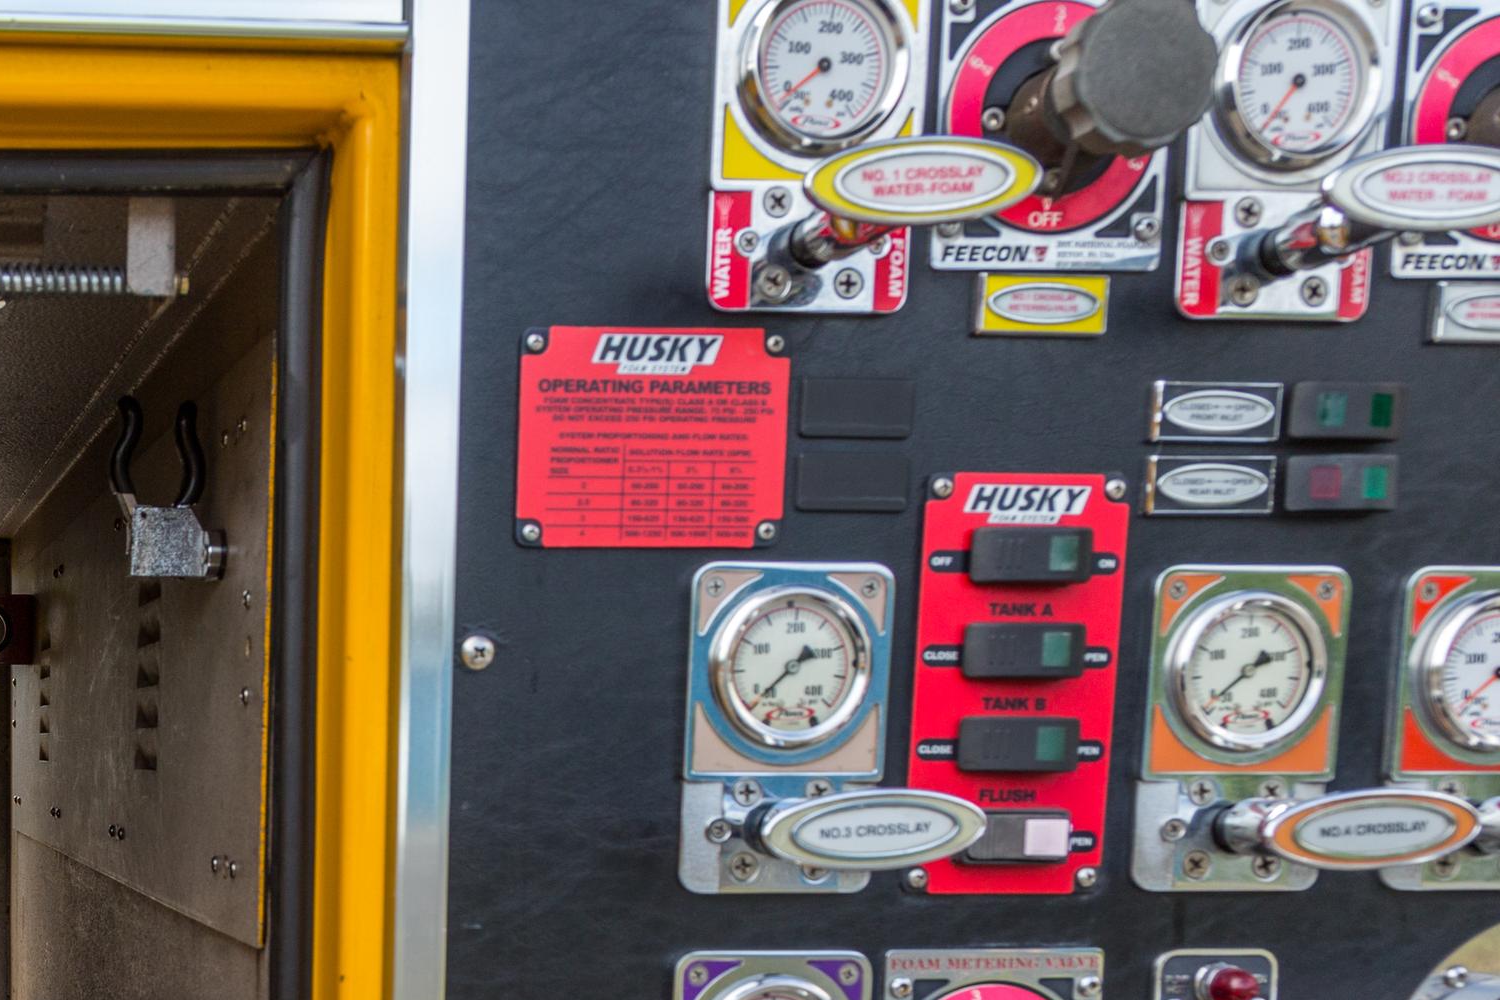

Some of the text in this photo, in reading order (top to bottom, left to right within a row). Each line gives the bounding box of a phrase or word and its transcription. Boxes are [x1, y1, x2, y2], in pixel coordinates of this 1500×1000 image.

[818, 20, 843, 34] 200
[788, 41, 811, 54] 100
[1287, 37, 1312, 51] 200
[840, 51, 864, 65] 300
[783, 80, 792, 92] 0
[830, 89, 854, 102] 400
[905, 165, 985, 181] CROSSLAY
[1419, 171, 1491, 183] CROSSLAY
[872, 182, 974, 196] WATER-FOAM
[1388, 190, 1488, 201] WATER FOAM
[1028, 212, 1064, 226] OFF
[941, 246, 1029, 262] FEECON
[712, 227, 733, 299] WATER
[888, 238, 904, 298] FOAM
[1402, 254, 1486, 270] FEECON
[1183, 237, 1202, 306] WATER
[600, 335, 718, 362] HUSKY
[538, 379, 771, 395] OPERATING PARAMETERS
[971, 487, 1086, 512] HUSKY
[930, 556, 954, 567] OFF
[1098, 559, 1116, 570] ON
[988, 603, 1053, 616] TANK A
[786, 622, 806, 634] 200
[1241, 627, 1260, 639] 200
[754, 643, 770, 654] 100
[814, 648, 833, 659] 300
[1209, 649, 1225, 660] 100
[923, 650, 960, 661] CLOSE
[1084, 652, 1108, 662] PEN
[754, 683, 760, 694] 0
[804, 685, 823, 696] 400
[1260, 687, 1278, 698] 400
[981, 697, 1046, 711] TANK B
[917, 744, 954, 755] CLOSE
[1077, 746, 1100, 756] PEN
[979, 789, 1036, 802] FLUSH
[855, 821, 931, 837] CROSSLAY
[1356, 821, 1428, 836] CROSSLAY
[1070, 836, 1093, 847] PEN
[891, 956, 1100, 970] FOAM METERING VALVE
